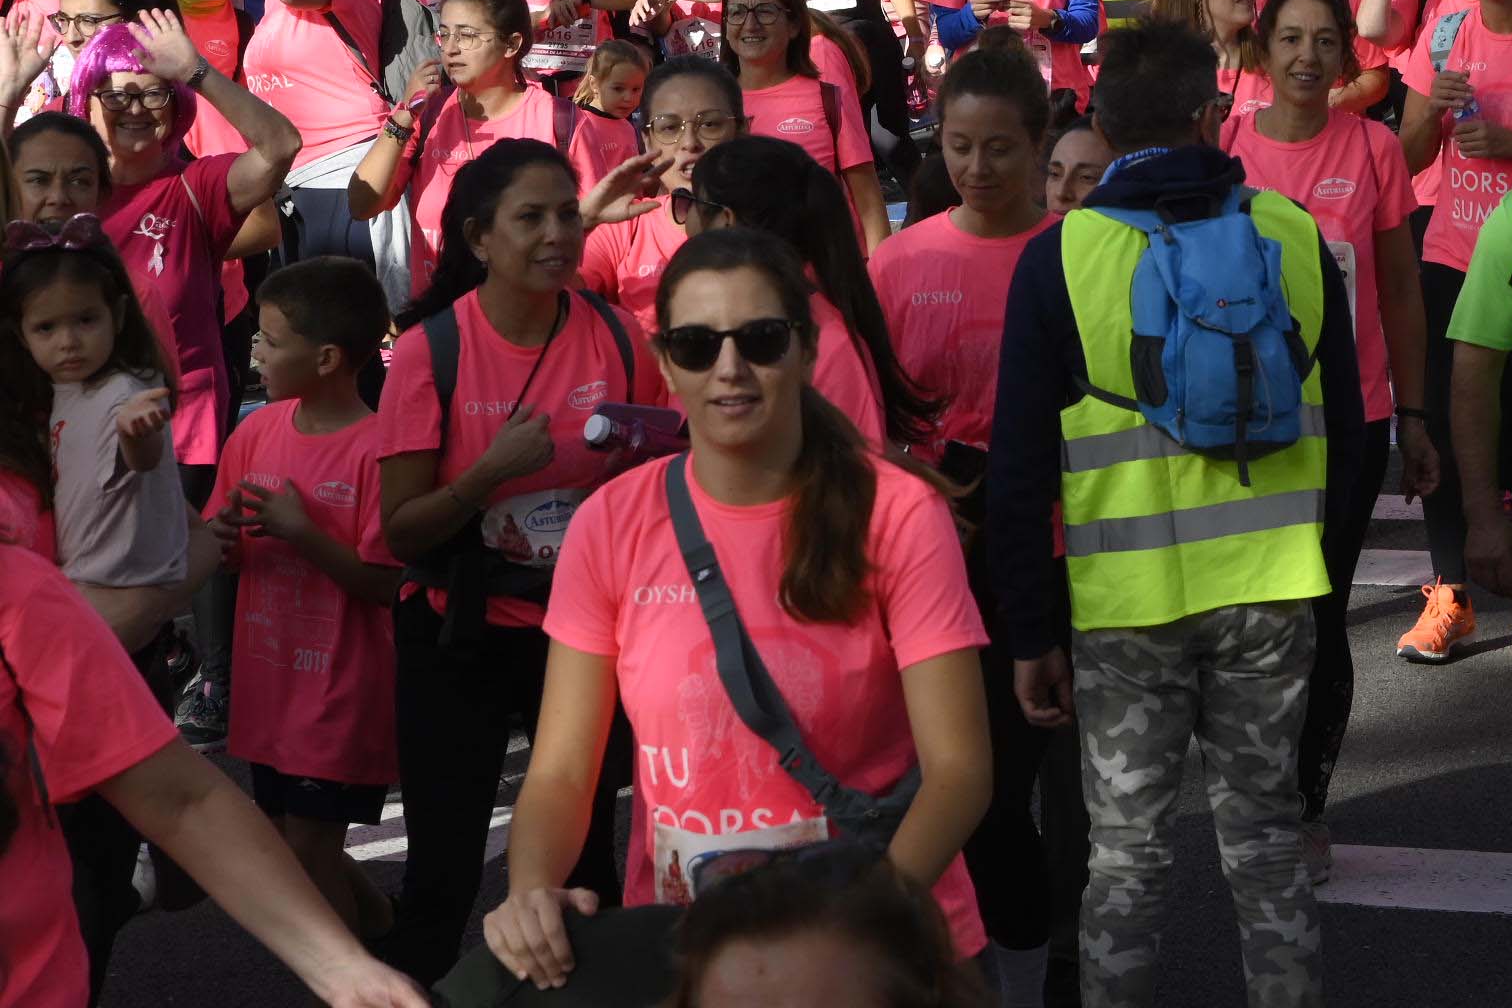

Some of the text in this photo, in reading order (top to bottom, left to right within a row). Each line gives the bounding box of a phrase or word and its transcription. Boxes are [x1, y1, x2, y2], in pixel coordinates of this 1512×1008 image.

[247, 73, 295, 95] ORSAL
[1451, 198, 1495, 224] SUM
[911, 289, 963, 305] OYSHO
[464, 400, 522, 416] OYSHO
[633, 584, 696, 606] OYSH
[640, 745, 690, 789] TU
